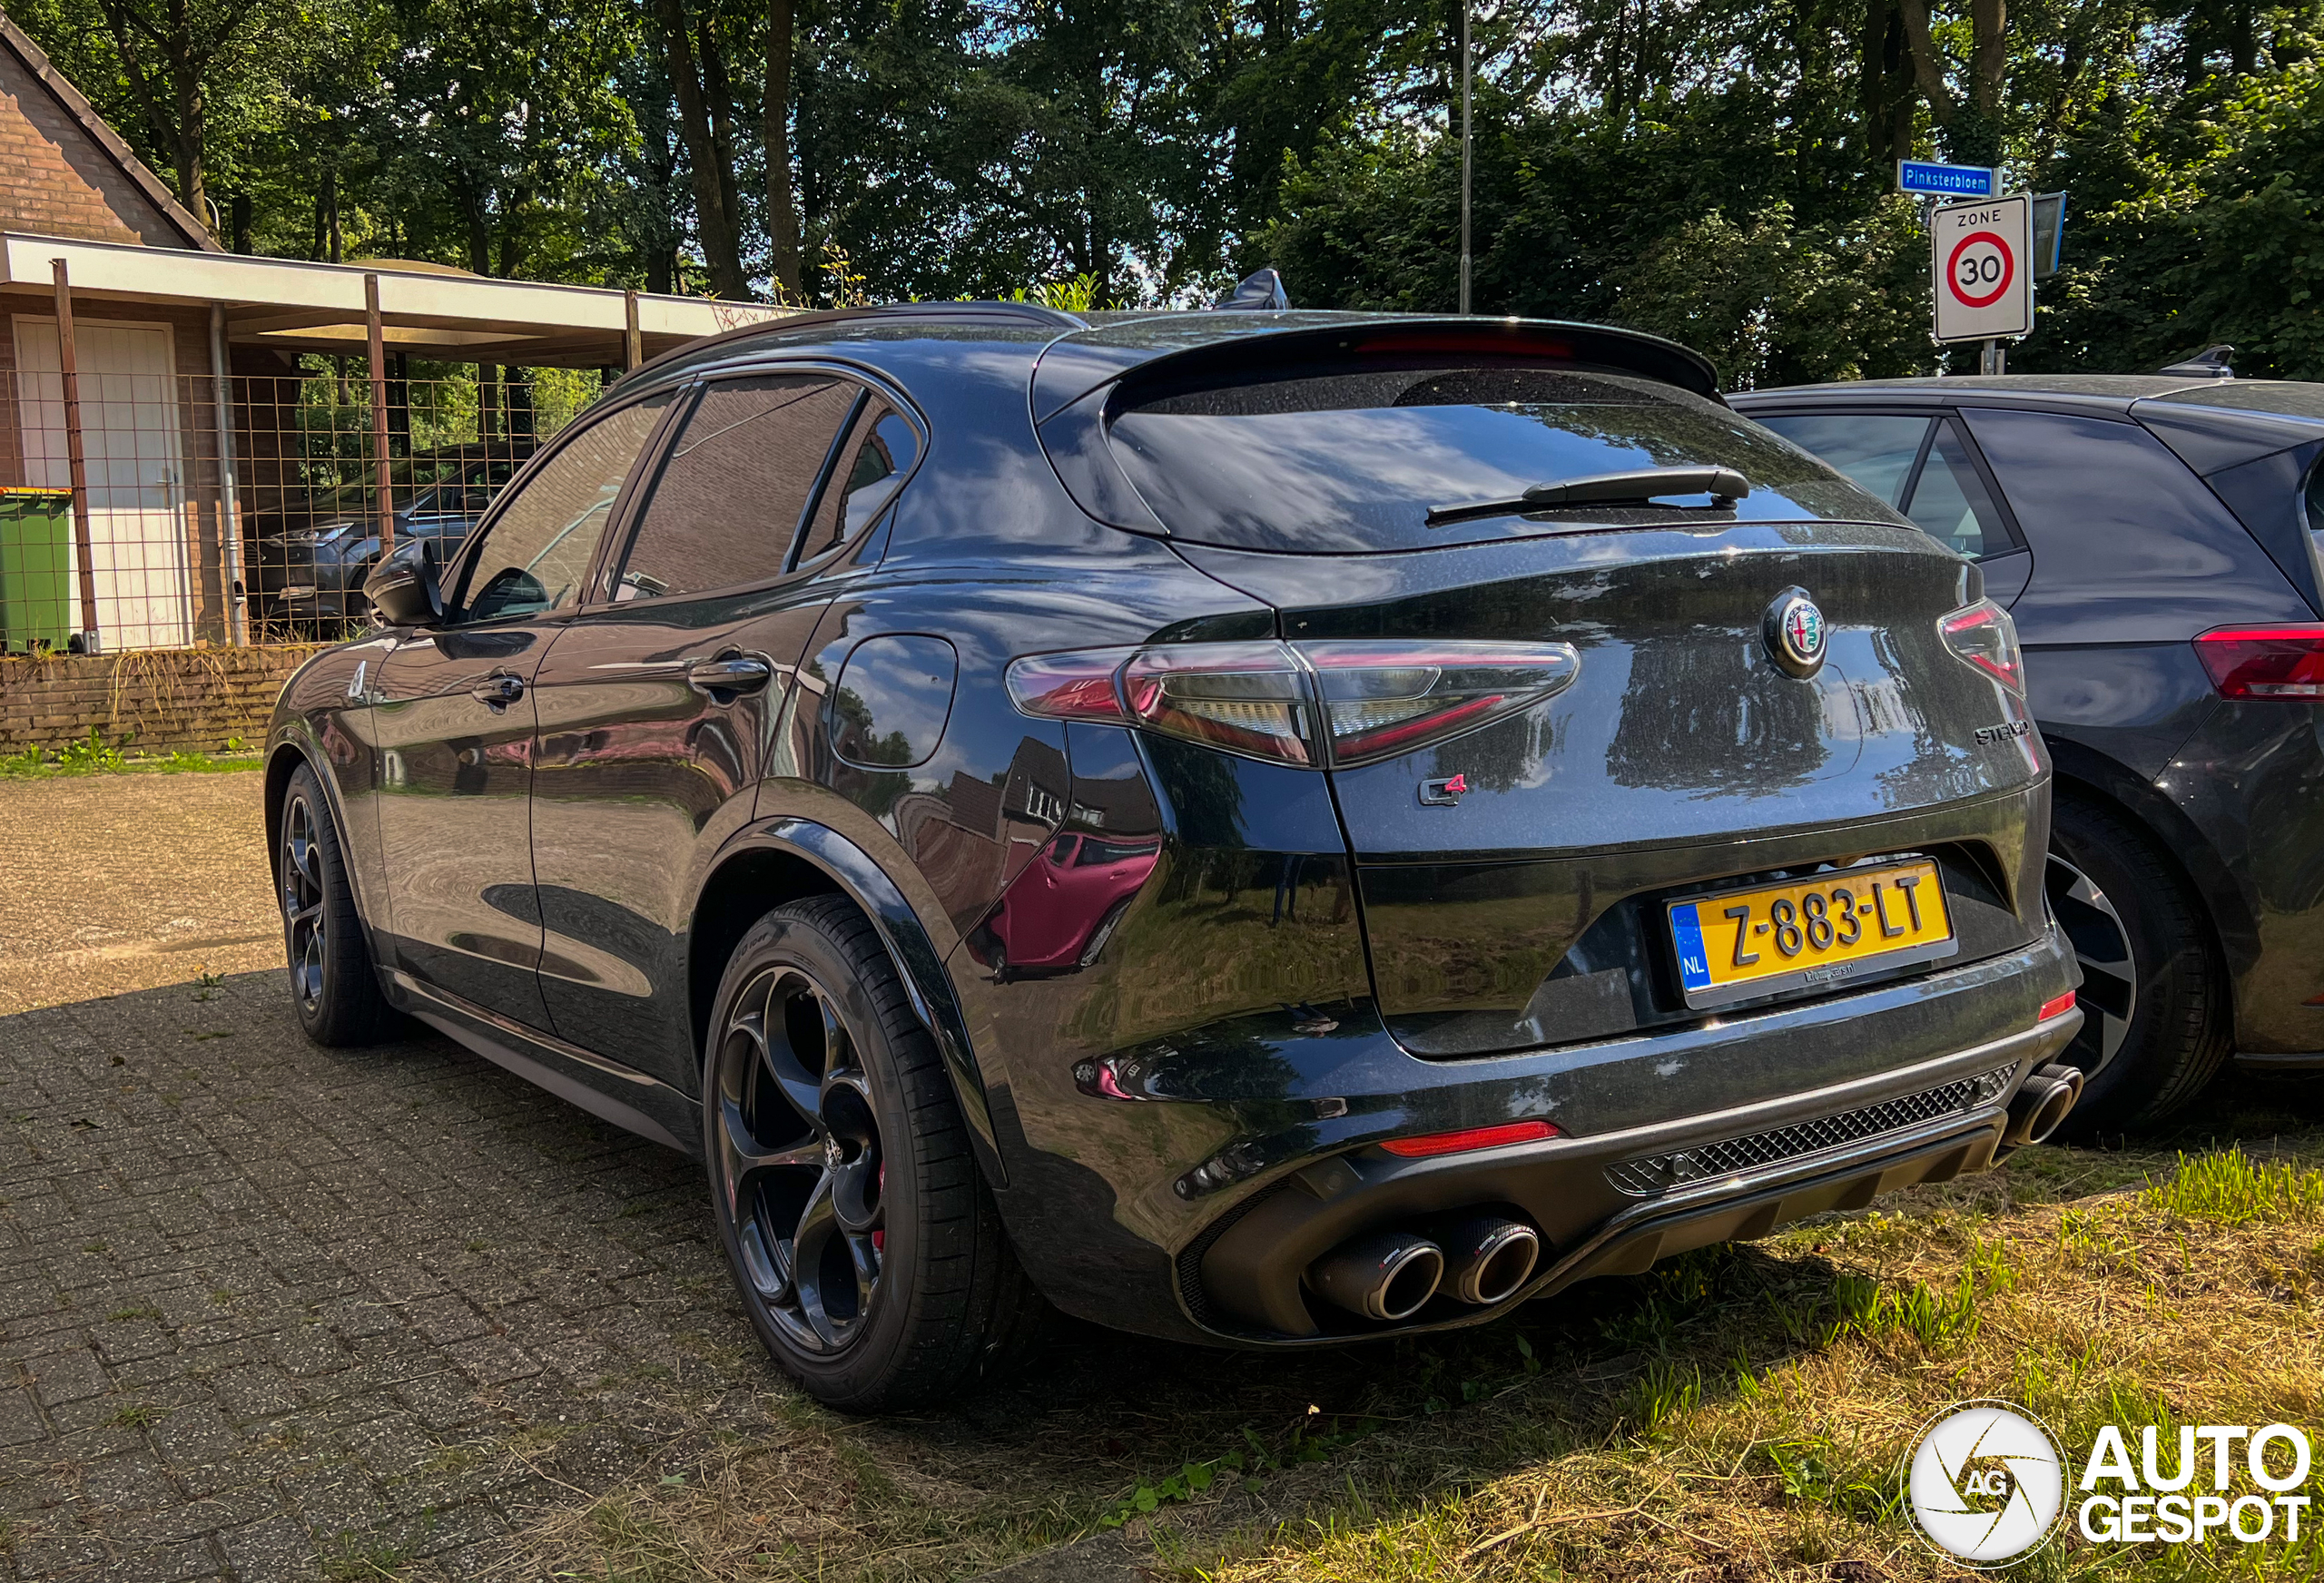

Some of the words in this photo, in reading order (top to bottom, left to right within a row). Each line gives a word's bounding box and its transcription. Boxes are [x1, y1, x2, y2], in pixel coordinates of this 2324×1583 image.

[1906, 169, 1987, 190] Pinksterbloem
[1957, 210, 2001, 227] ZONE
[1960, 255, 2001, 285] 30
[1787, 608, 1798, 633] ALFA
[1725, 876, 1920, 967] Z-883-LT
[1683, 956, 1705, 976] NL
